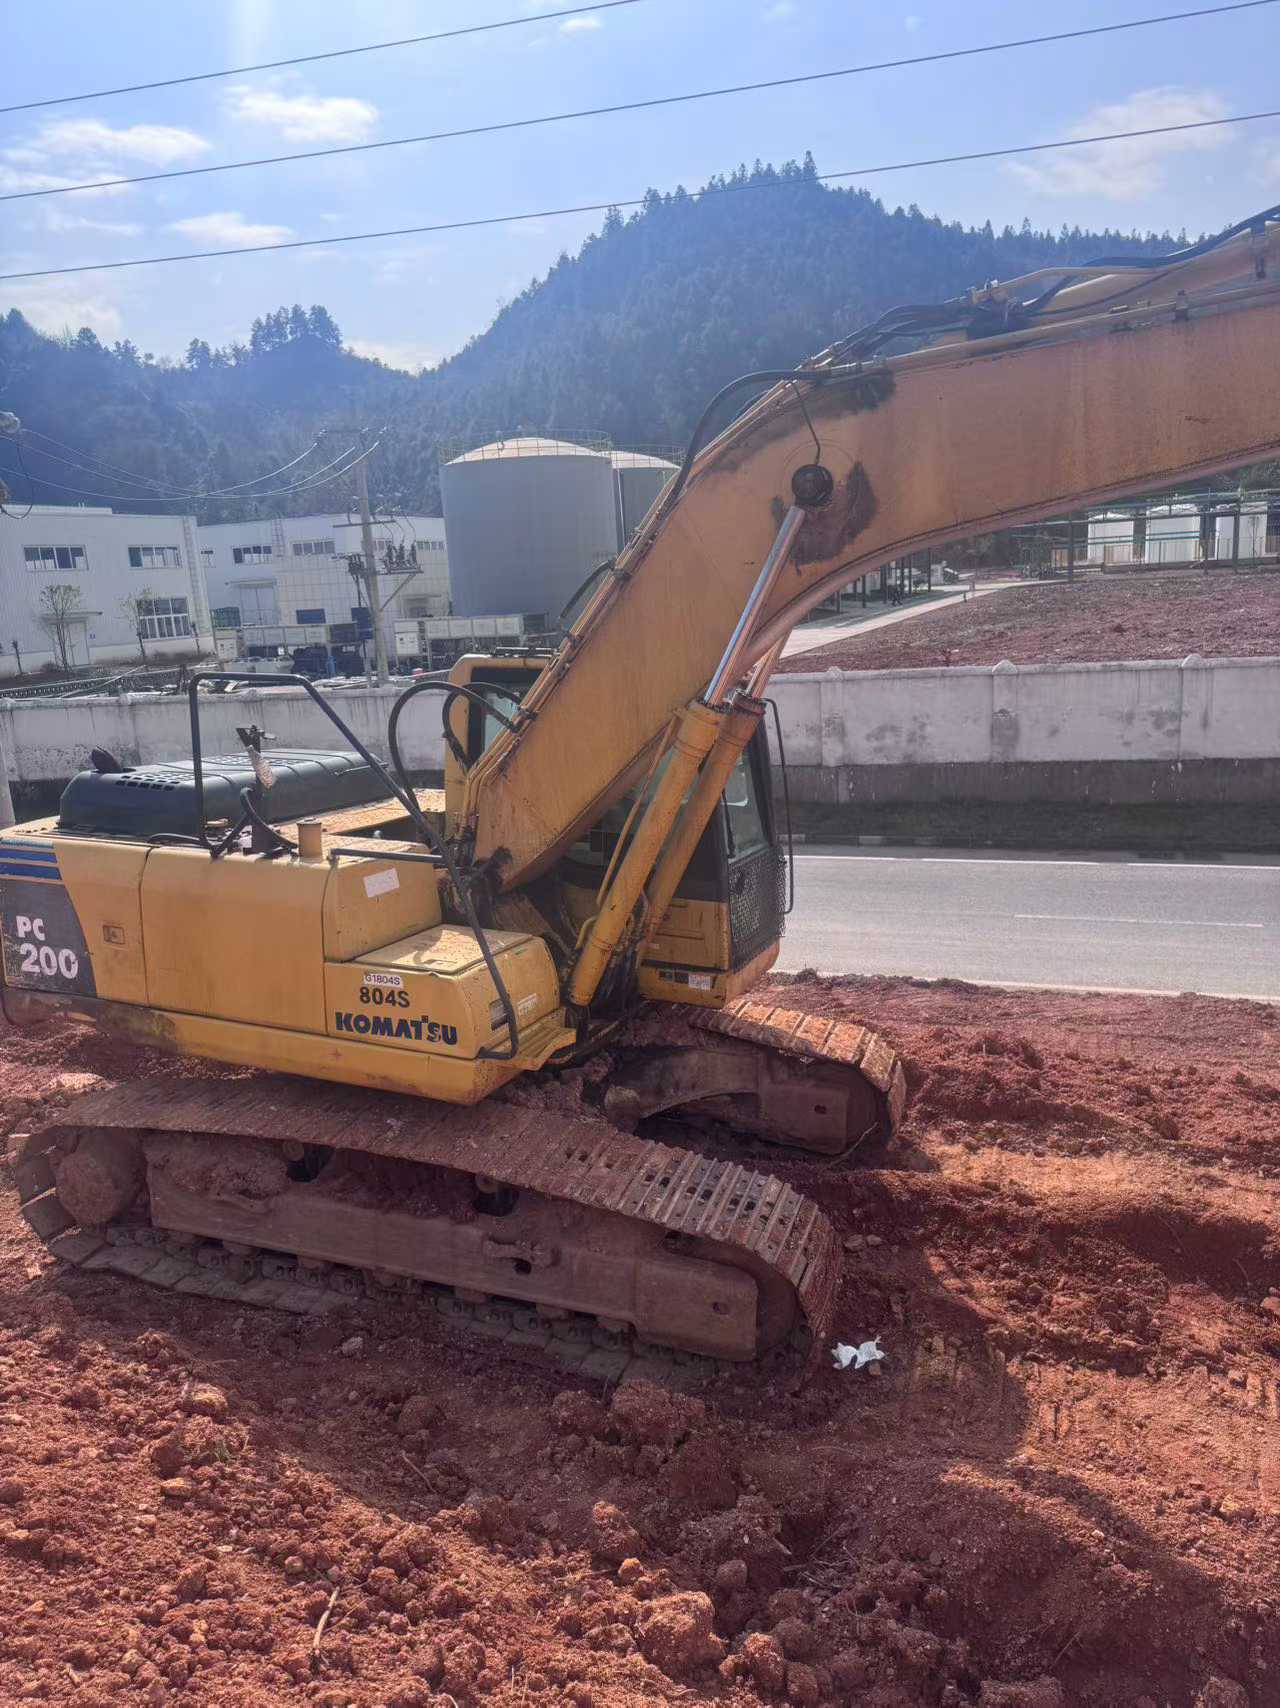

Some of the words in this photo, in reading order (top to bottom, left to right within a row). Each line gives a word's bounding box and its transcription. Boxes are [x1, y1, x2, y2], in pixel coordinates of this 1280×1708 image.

[16, 915, 46, 941] PC
[20, 943, 79, 979] 200
[360, 987, 411, 1008] 804S
[335, 1012, 458, 1045] KOMATSU
